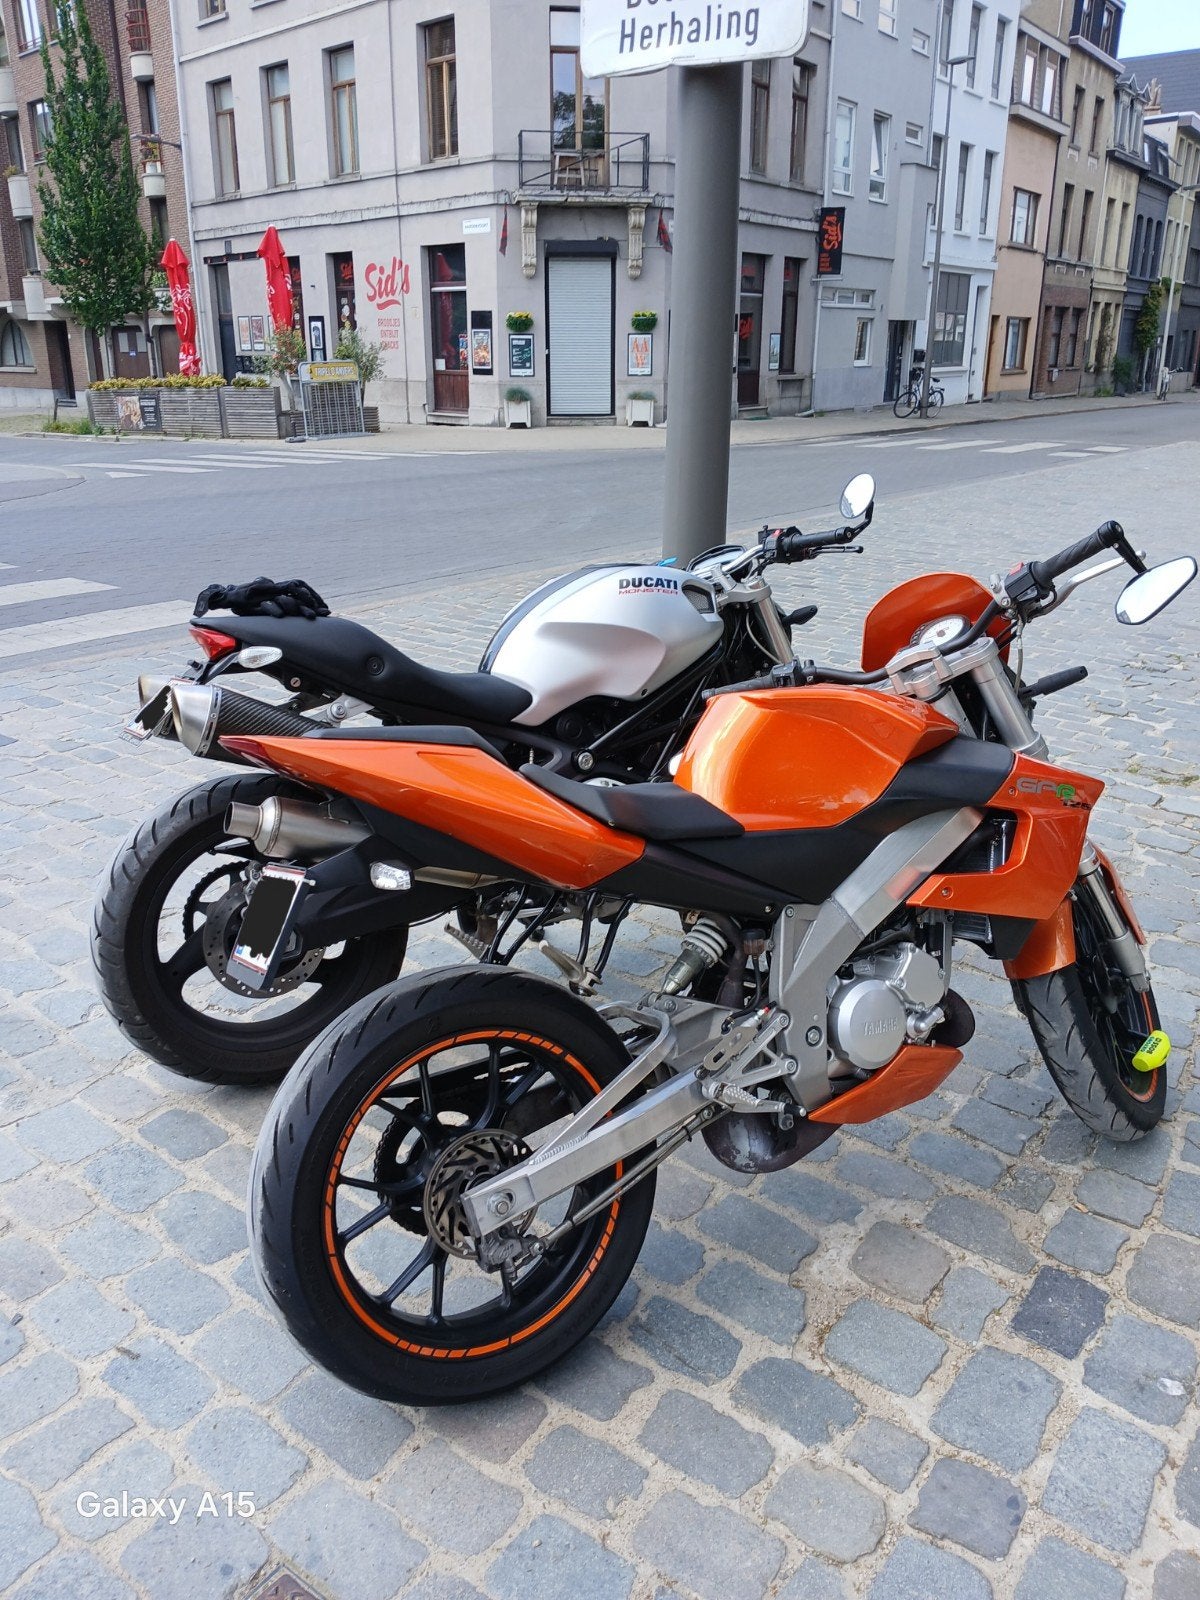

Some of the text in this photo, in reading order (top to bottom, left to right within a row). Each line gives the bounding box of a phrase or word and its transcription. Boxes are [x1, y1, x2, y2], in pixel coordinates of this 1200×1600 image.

[618, 5, 760, 54] Herhaling
[365, 256, 410, 302] Sid's
[618, 576, 678, 590] DUCATI
[864, 1017, 898, 1036] YAMAHA
